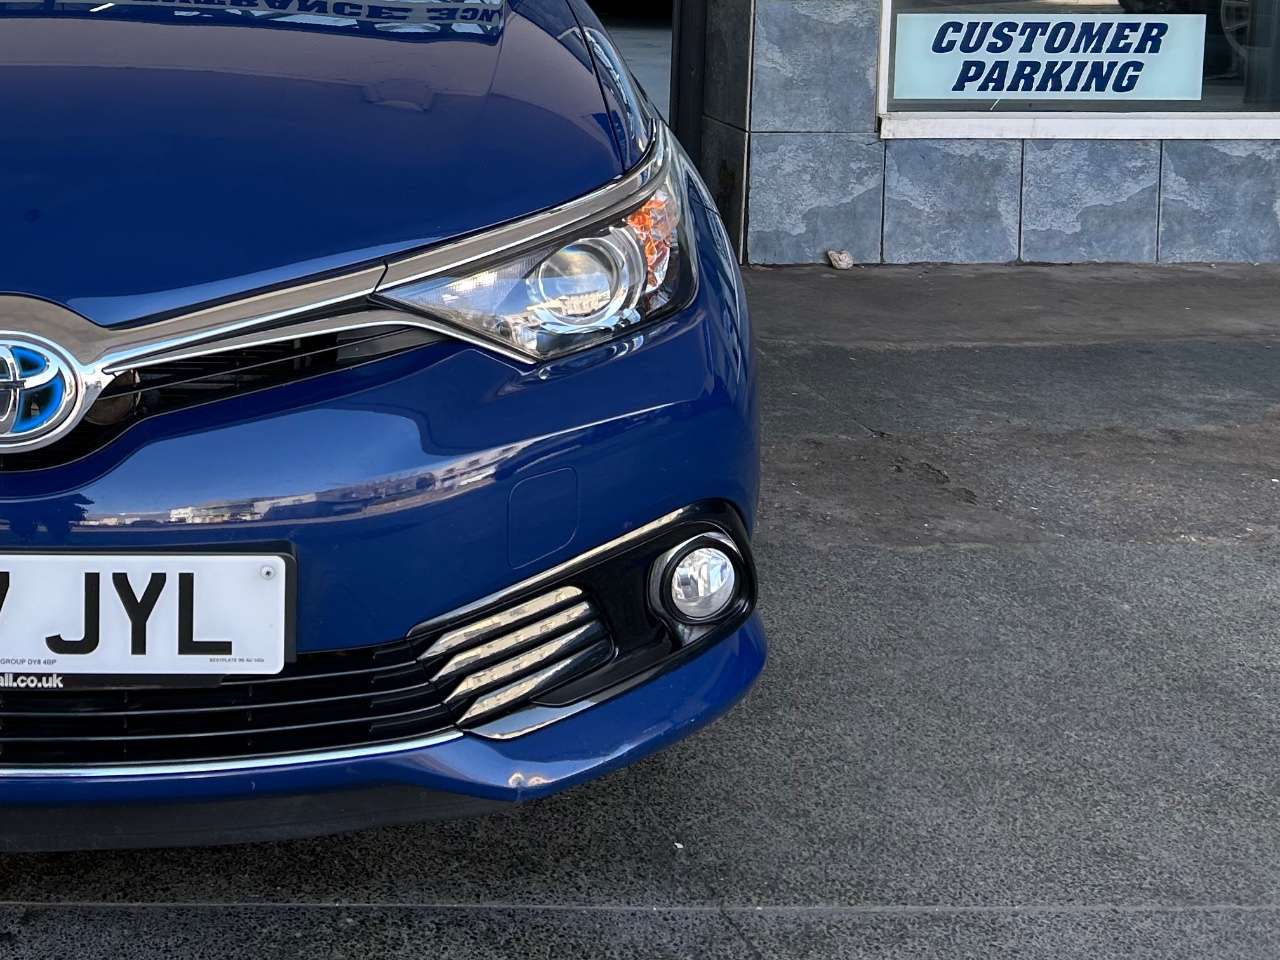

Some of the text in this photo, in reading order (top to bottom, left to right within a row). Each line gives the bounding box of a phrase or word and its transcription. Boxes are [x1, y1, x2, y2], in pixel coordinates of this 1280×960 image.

[931, 21, 1169, 54] CUSTOMER
[951, 60, 1144, 93] PARKING
[45, 572, 233, 656] JYL
